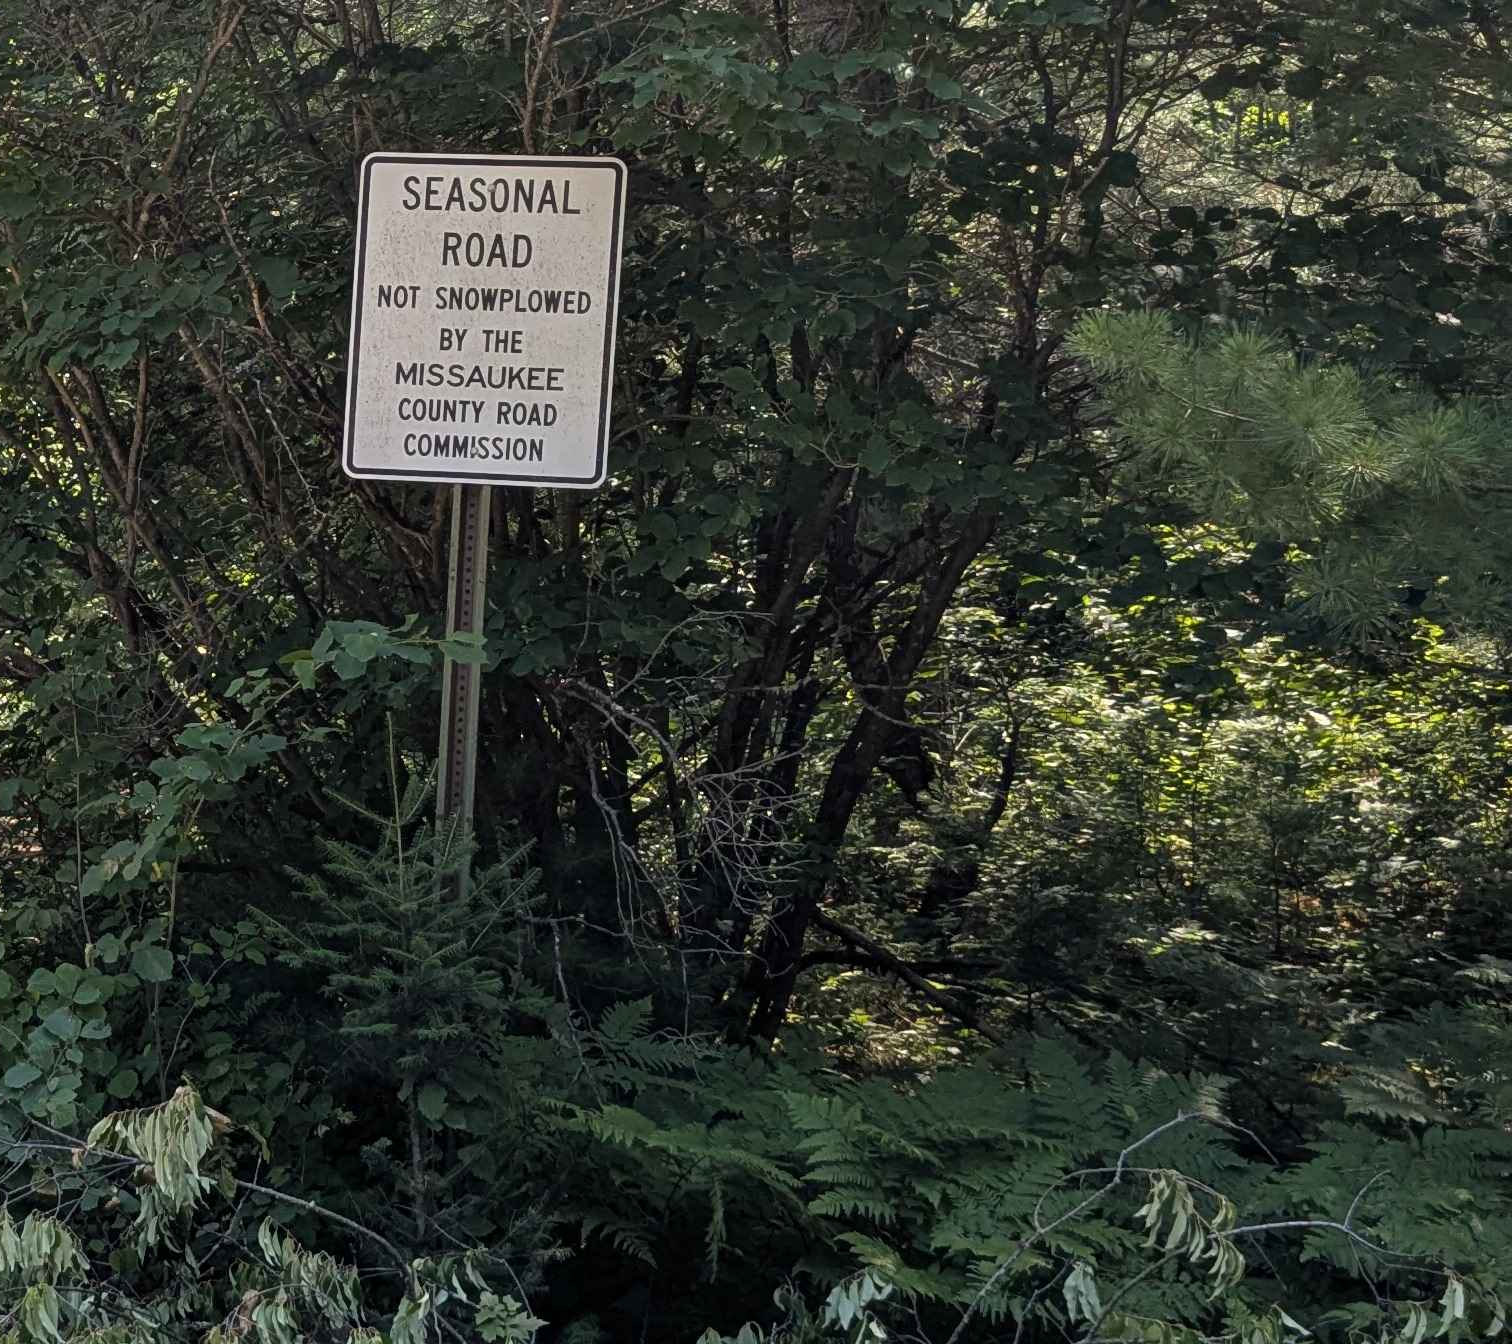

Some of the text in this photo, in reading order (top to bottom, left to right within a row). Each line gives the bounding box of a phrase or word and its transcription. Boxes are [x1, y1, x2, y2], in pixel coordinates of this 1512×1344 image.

[402, 175, 581, 215] SEASONAL
[441, 231, 533, 269] ROAD
[377, 284, 592, 315] NOT SNOWPLOWED
[439, 327, 523, 354] BY THE
[395, 361, 565, 392] MISSAUKEE
[398, 397, 558, 427] COUNTY ROAD
[403, 433, 544, 462] COMMISSION
